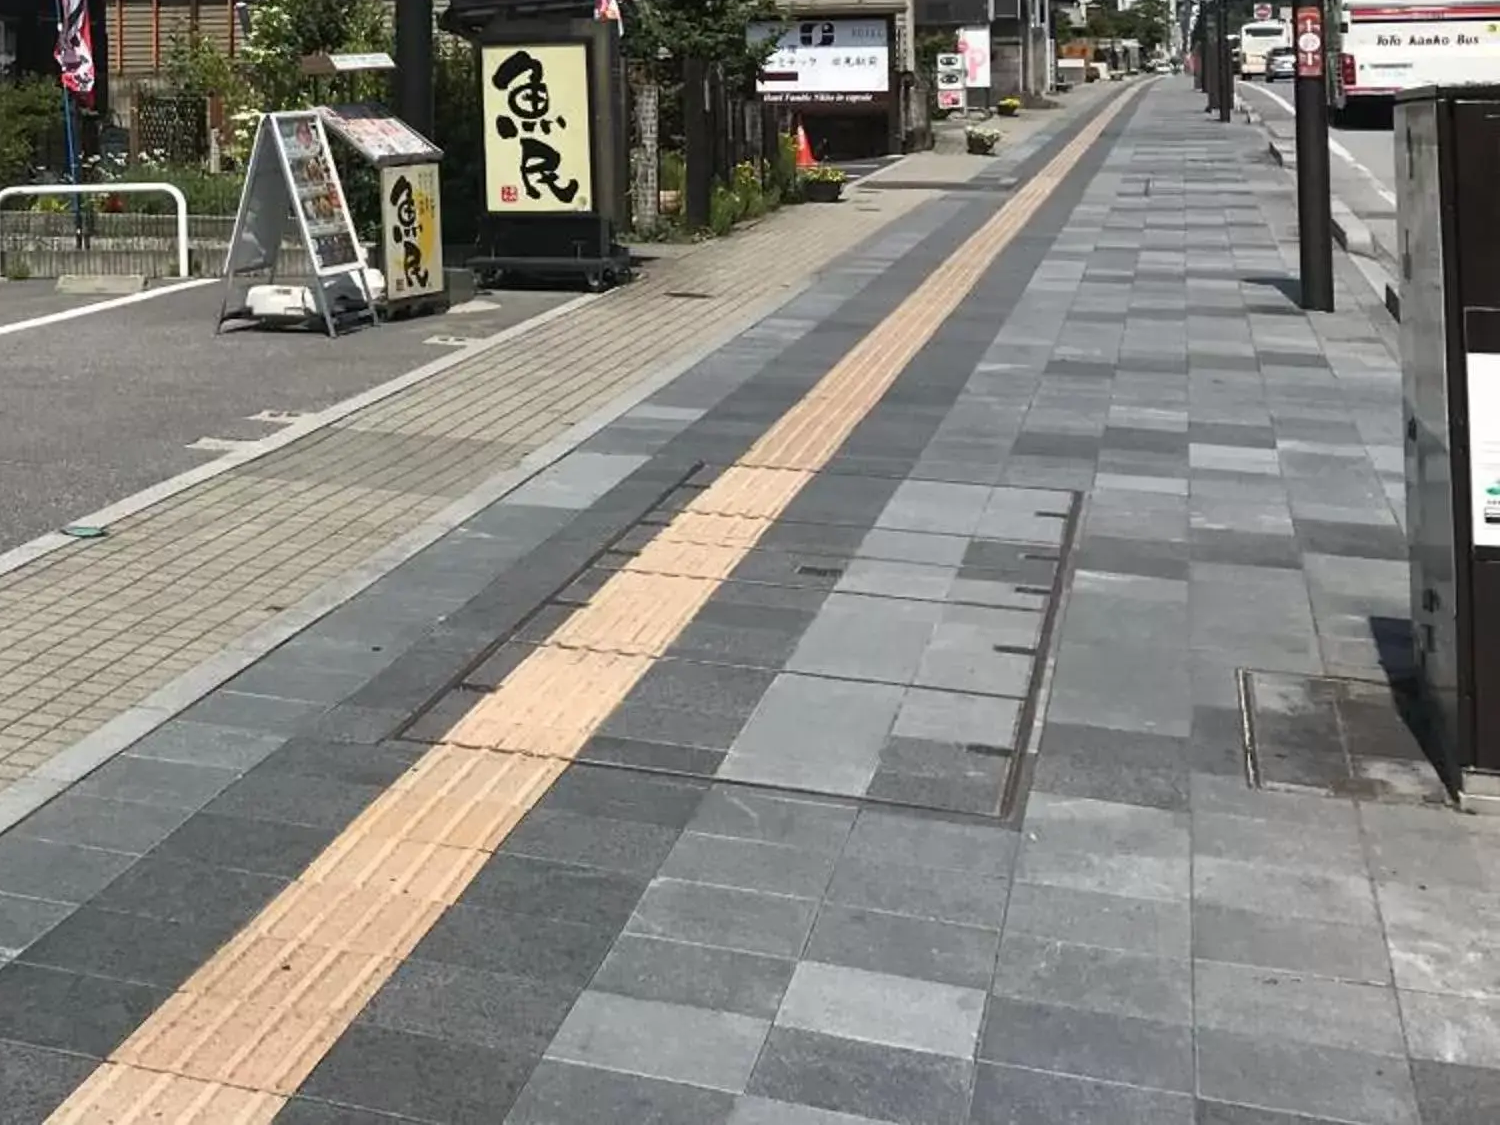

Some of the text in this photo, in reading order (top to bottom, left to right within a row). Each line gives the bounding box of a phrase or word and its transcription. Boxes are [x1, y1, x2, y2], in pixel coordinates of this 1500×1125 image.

[1456, 33, 1480, 45] Bus
[491, 49, 580, 204] 魚民
[389, 174, 429, 288] 魚民
